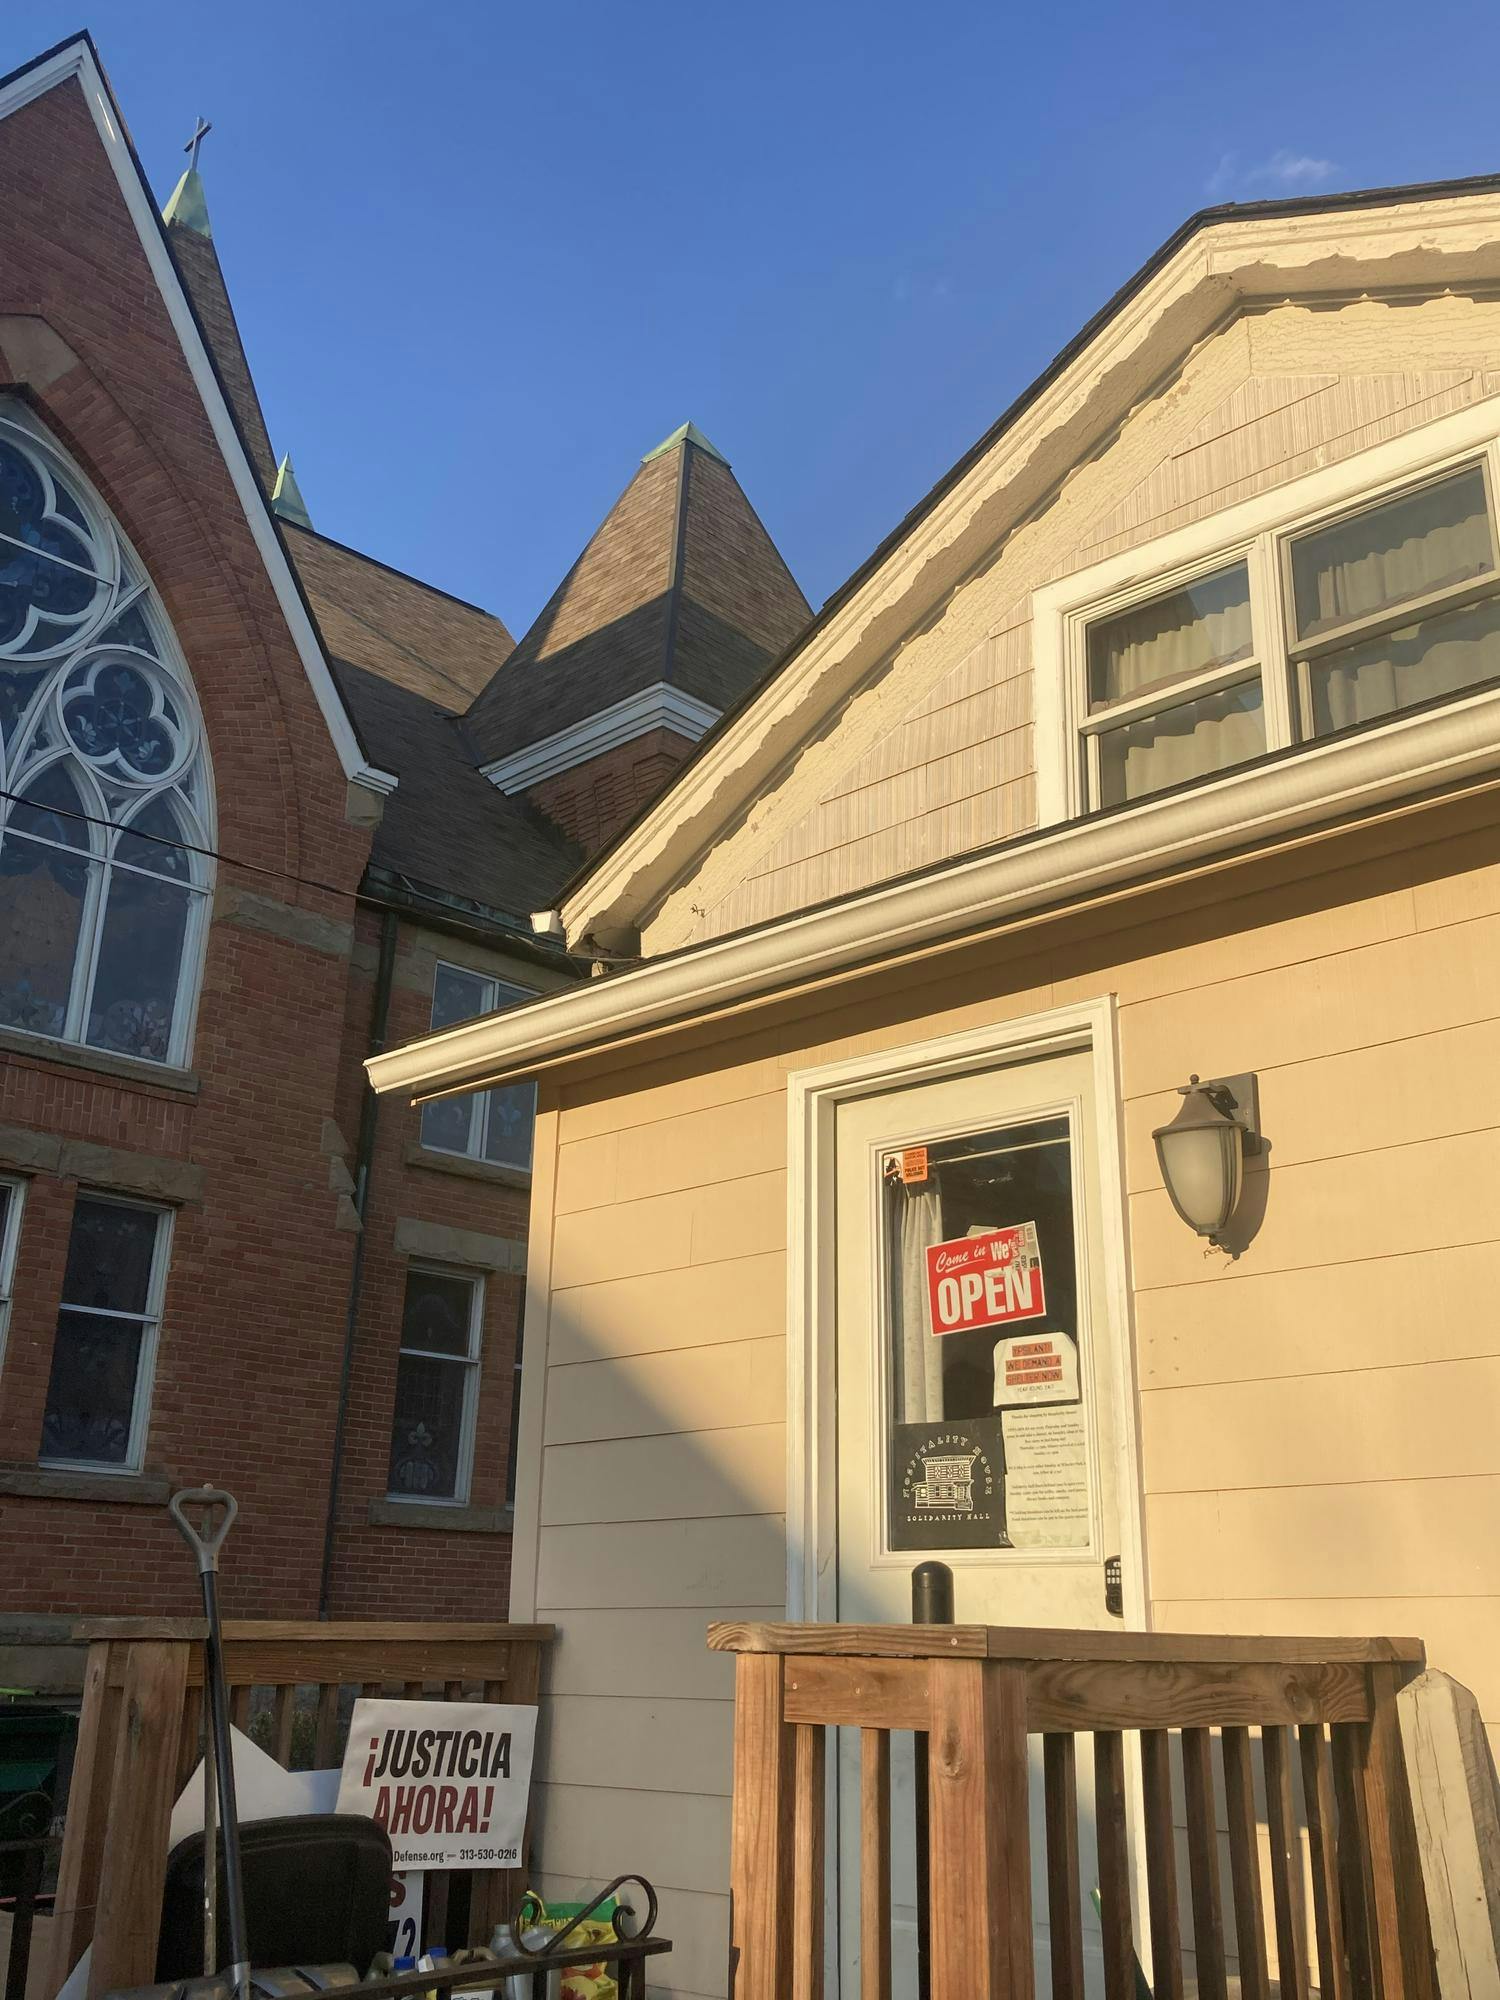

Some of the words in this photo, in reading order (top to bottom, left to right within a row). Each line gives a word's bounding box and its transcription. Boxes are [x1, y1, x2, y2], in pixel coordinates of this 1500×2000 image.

[935, 1251, 969, 1274] Come
[973, 1244, 986, 1257] in
[937, 1265, 1033, 1326] OPEN
[907, 1513, 962, 1521] SOLIDARITY
[966, 1512, 991, 1520] HALL
[363, 1729, 512, 1787] ¡JUSTICIA
[373, 1785, 494, 1835] AHORA!
[459, 1848, 517, 1861] 313-530-0216
